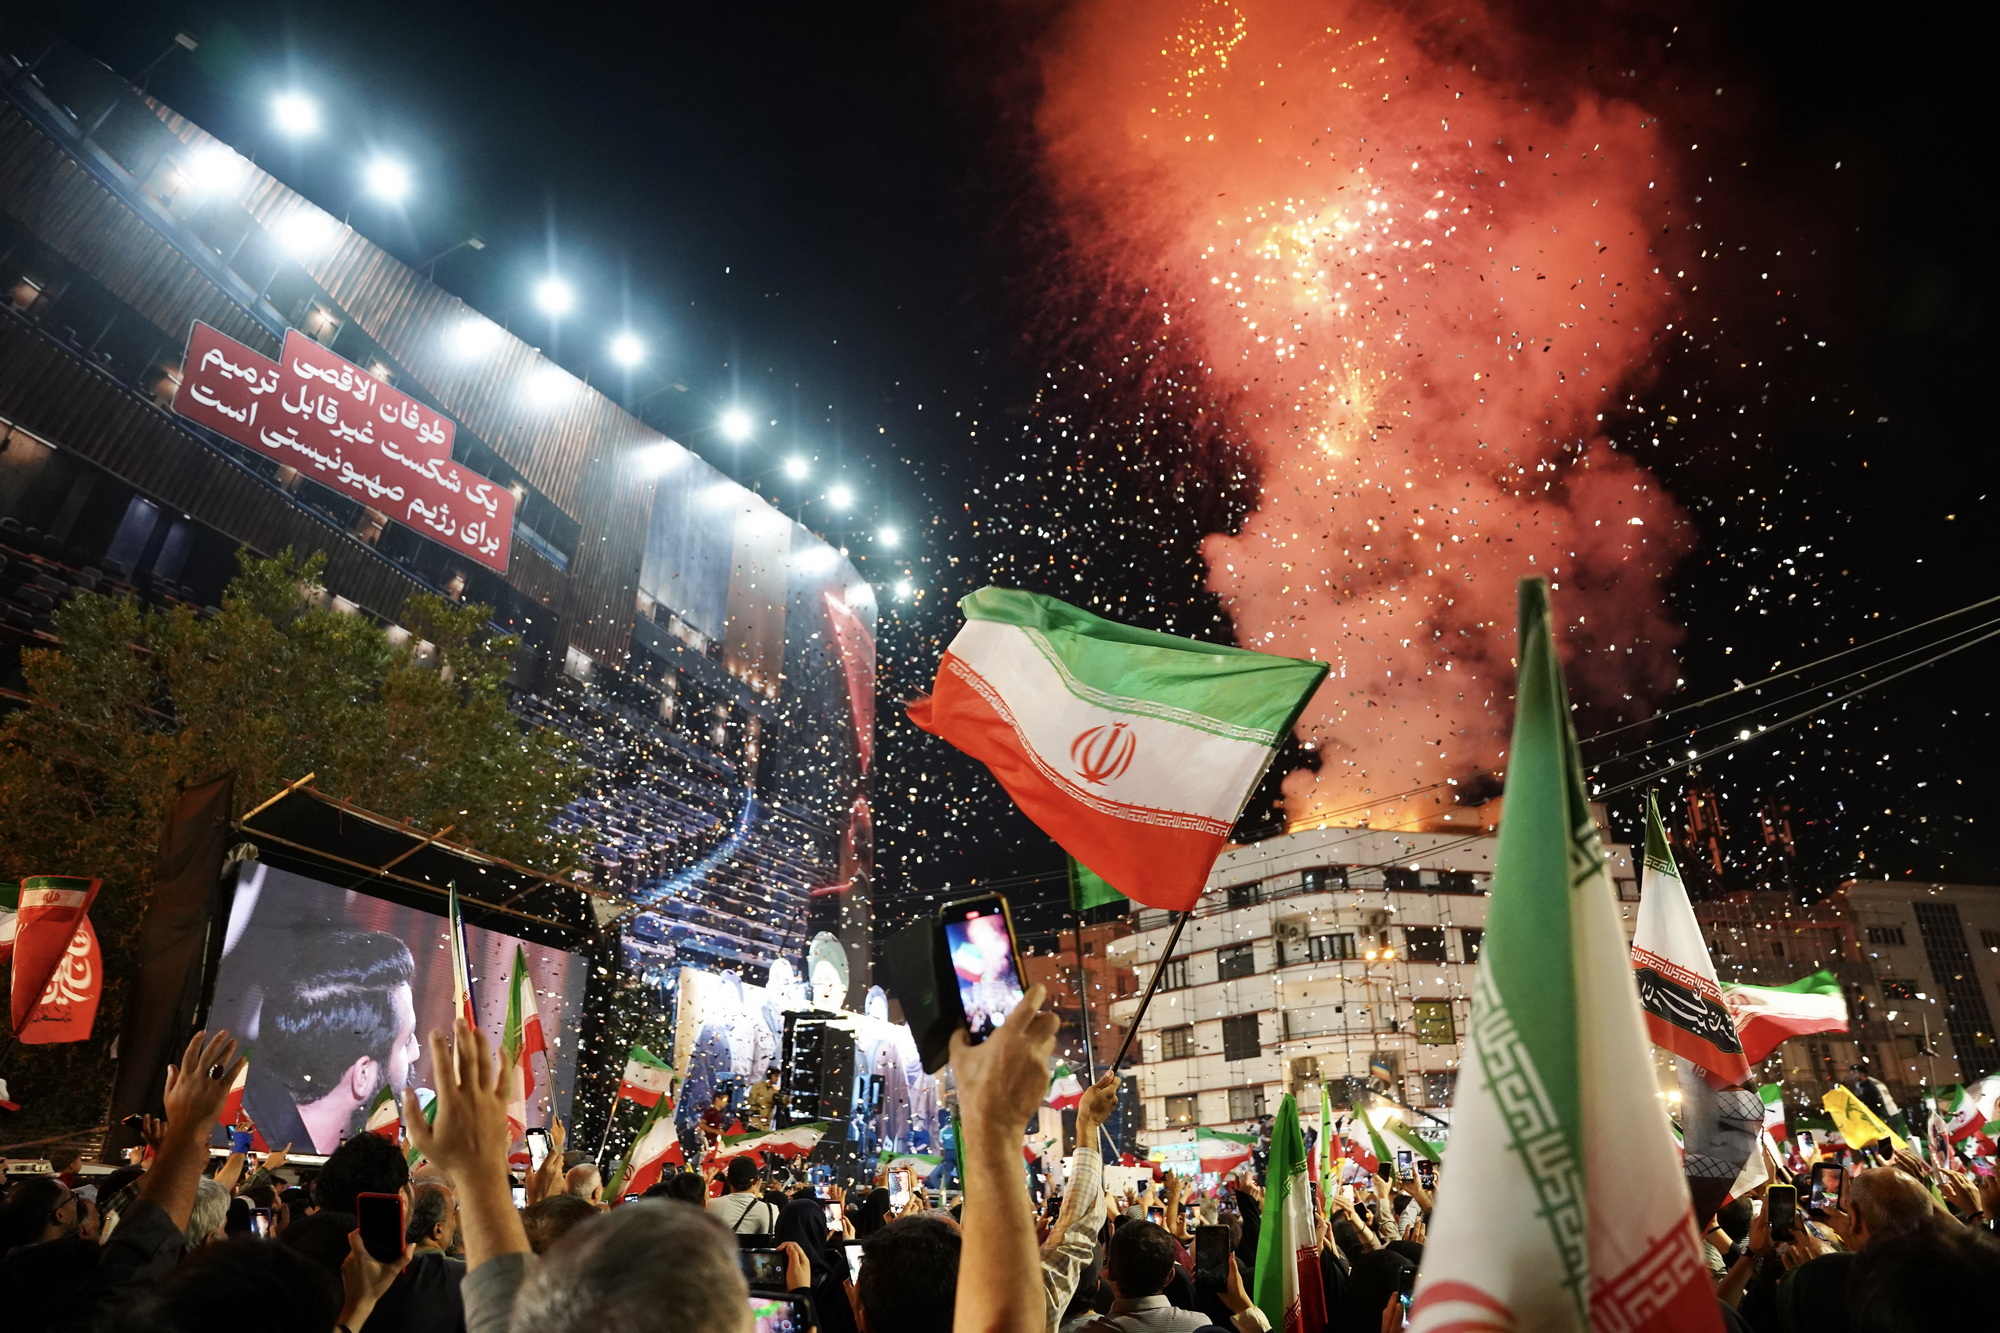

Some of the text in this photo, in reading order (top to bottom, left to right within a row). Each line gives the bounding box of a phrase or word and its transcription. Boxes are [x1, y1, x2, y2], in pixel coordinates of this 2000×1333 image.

[200, 347, 281, 395] ترمیم
[293, 356, 446, 445] طوفان الاقصی
[190, 381, 500, 557] برای رژیم صهیونیستی است
[380, 437, 462, 494] شکست
[465, 482, 499, 519] یک
